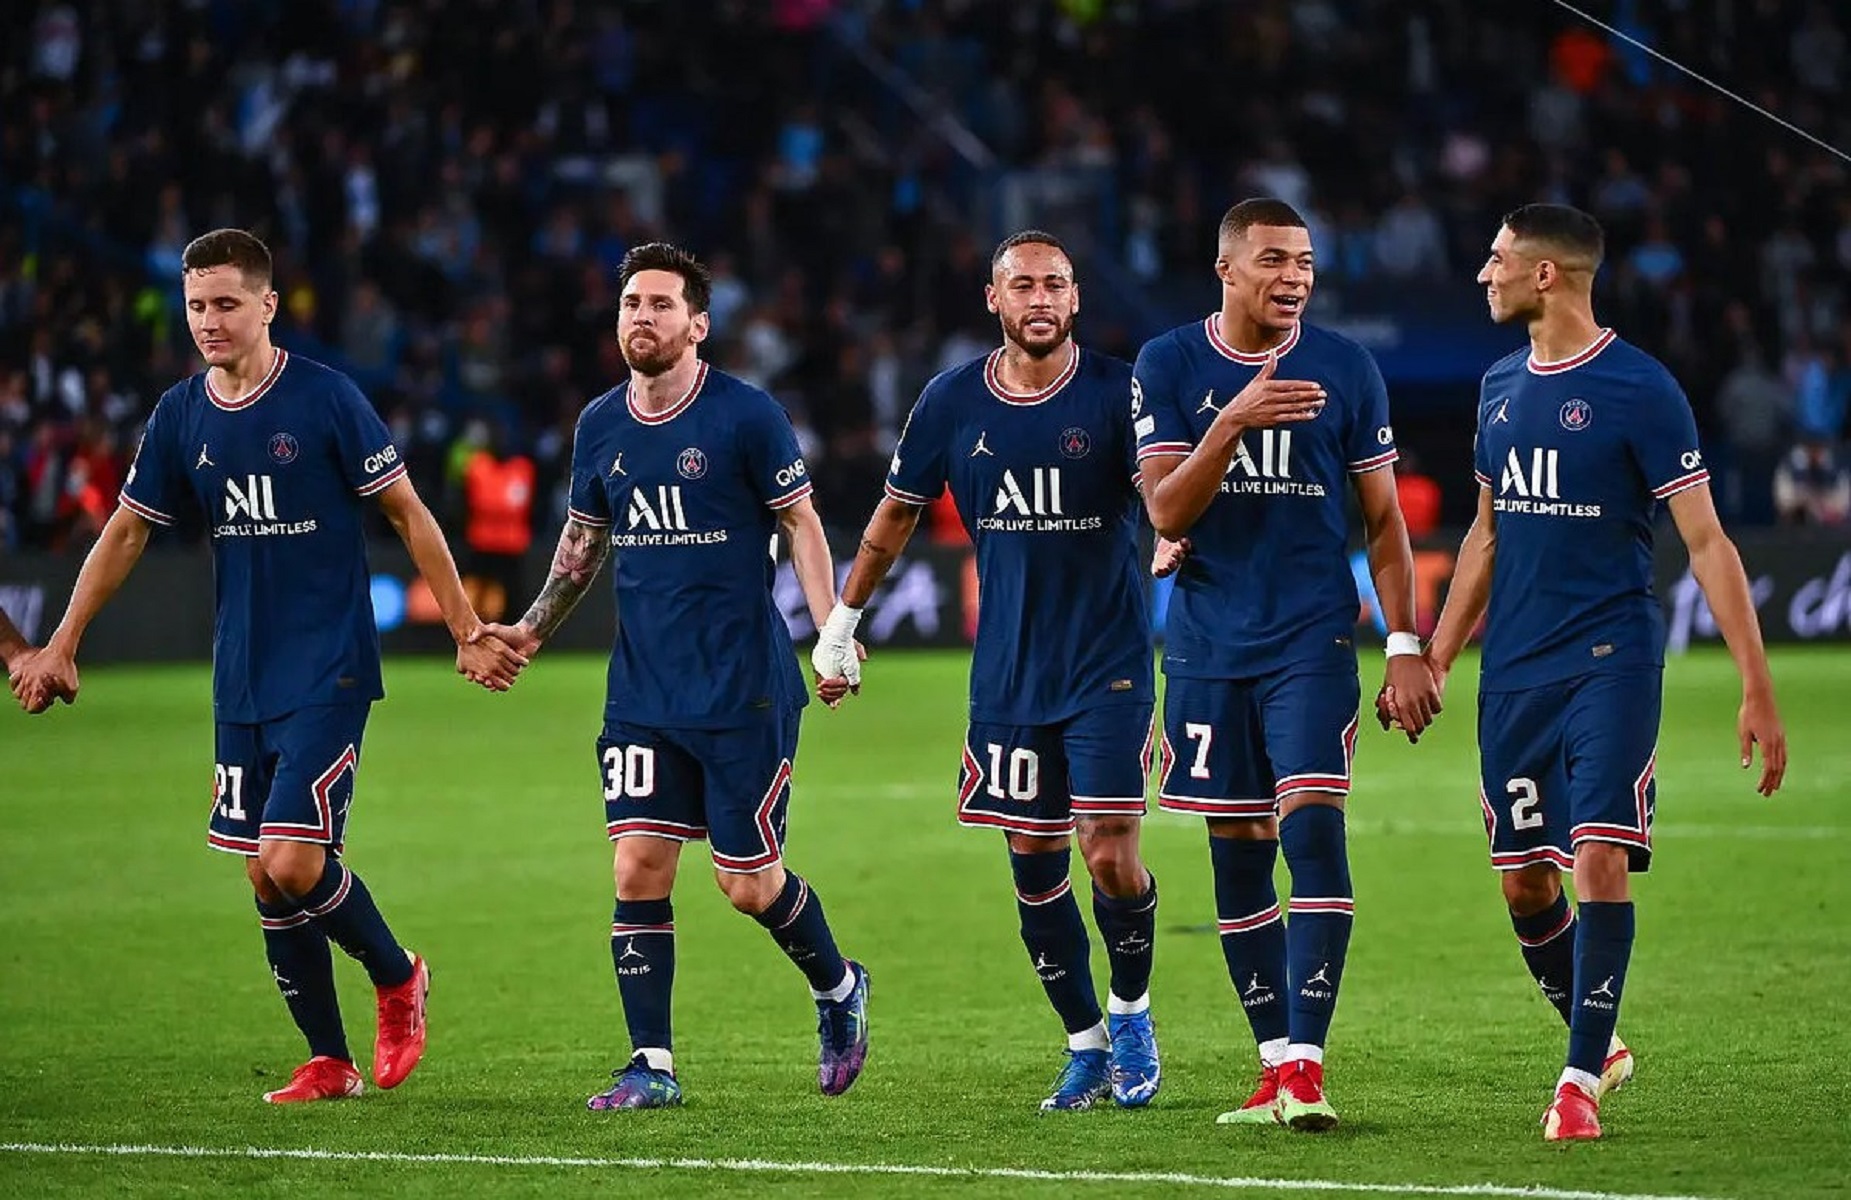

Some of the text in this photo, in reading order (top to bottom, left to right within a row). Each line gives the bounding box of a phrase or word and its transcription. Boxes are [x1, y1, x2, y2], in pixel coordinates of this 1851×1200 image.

[364, 444, 397, 474] QNB
[1681, 449, 1702, 470] QN
[775, 458, 806, 487] QNB
[1233, 481, 1261, 494] LIVE
[1507, 500, 1532, 513] LIVE
[1533, 501, 1601, 517] LIMITLESS
[254, 519, 317, 536] LIMITLESS
[1006, 519, 1034, 531] LIVE
[1037, 516, 1102, 531] LIMITLESS
[638, 534, 663, 547] LIVE
[664, 530, 728, 546] LIMITLESS
[1185, 721, 1213, 780] 7
[602, 744, 655, 802] 30
[986, 742, 1039, 802] 10
[214, 763, 247, 822] 21
[1505, 776, 1545, 832] 2
[618, 964, 651, 976] PARIS
[1243, 992, 1276, 1009] PARIS
[1300, 987, 1333, 999] PARIS
